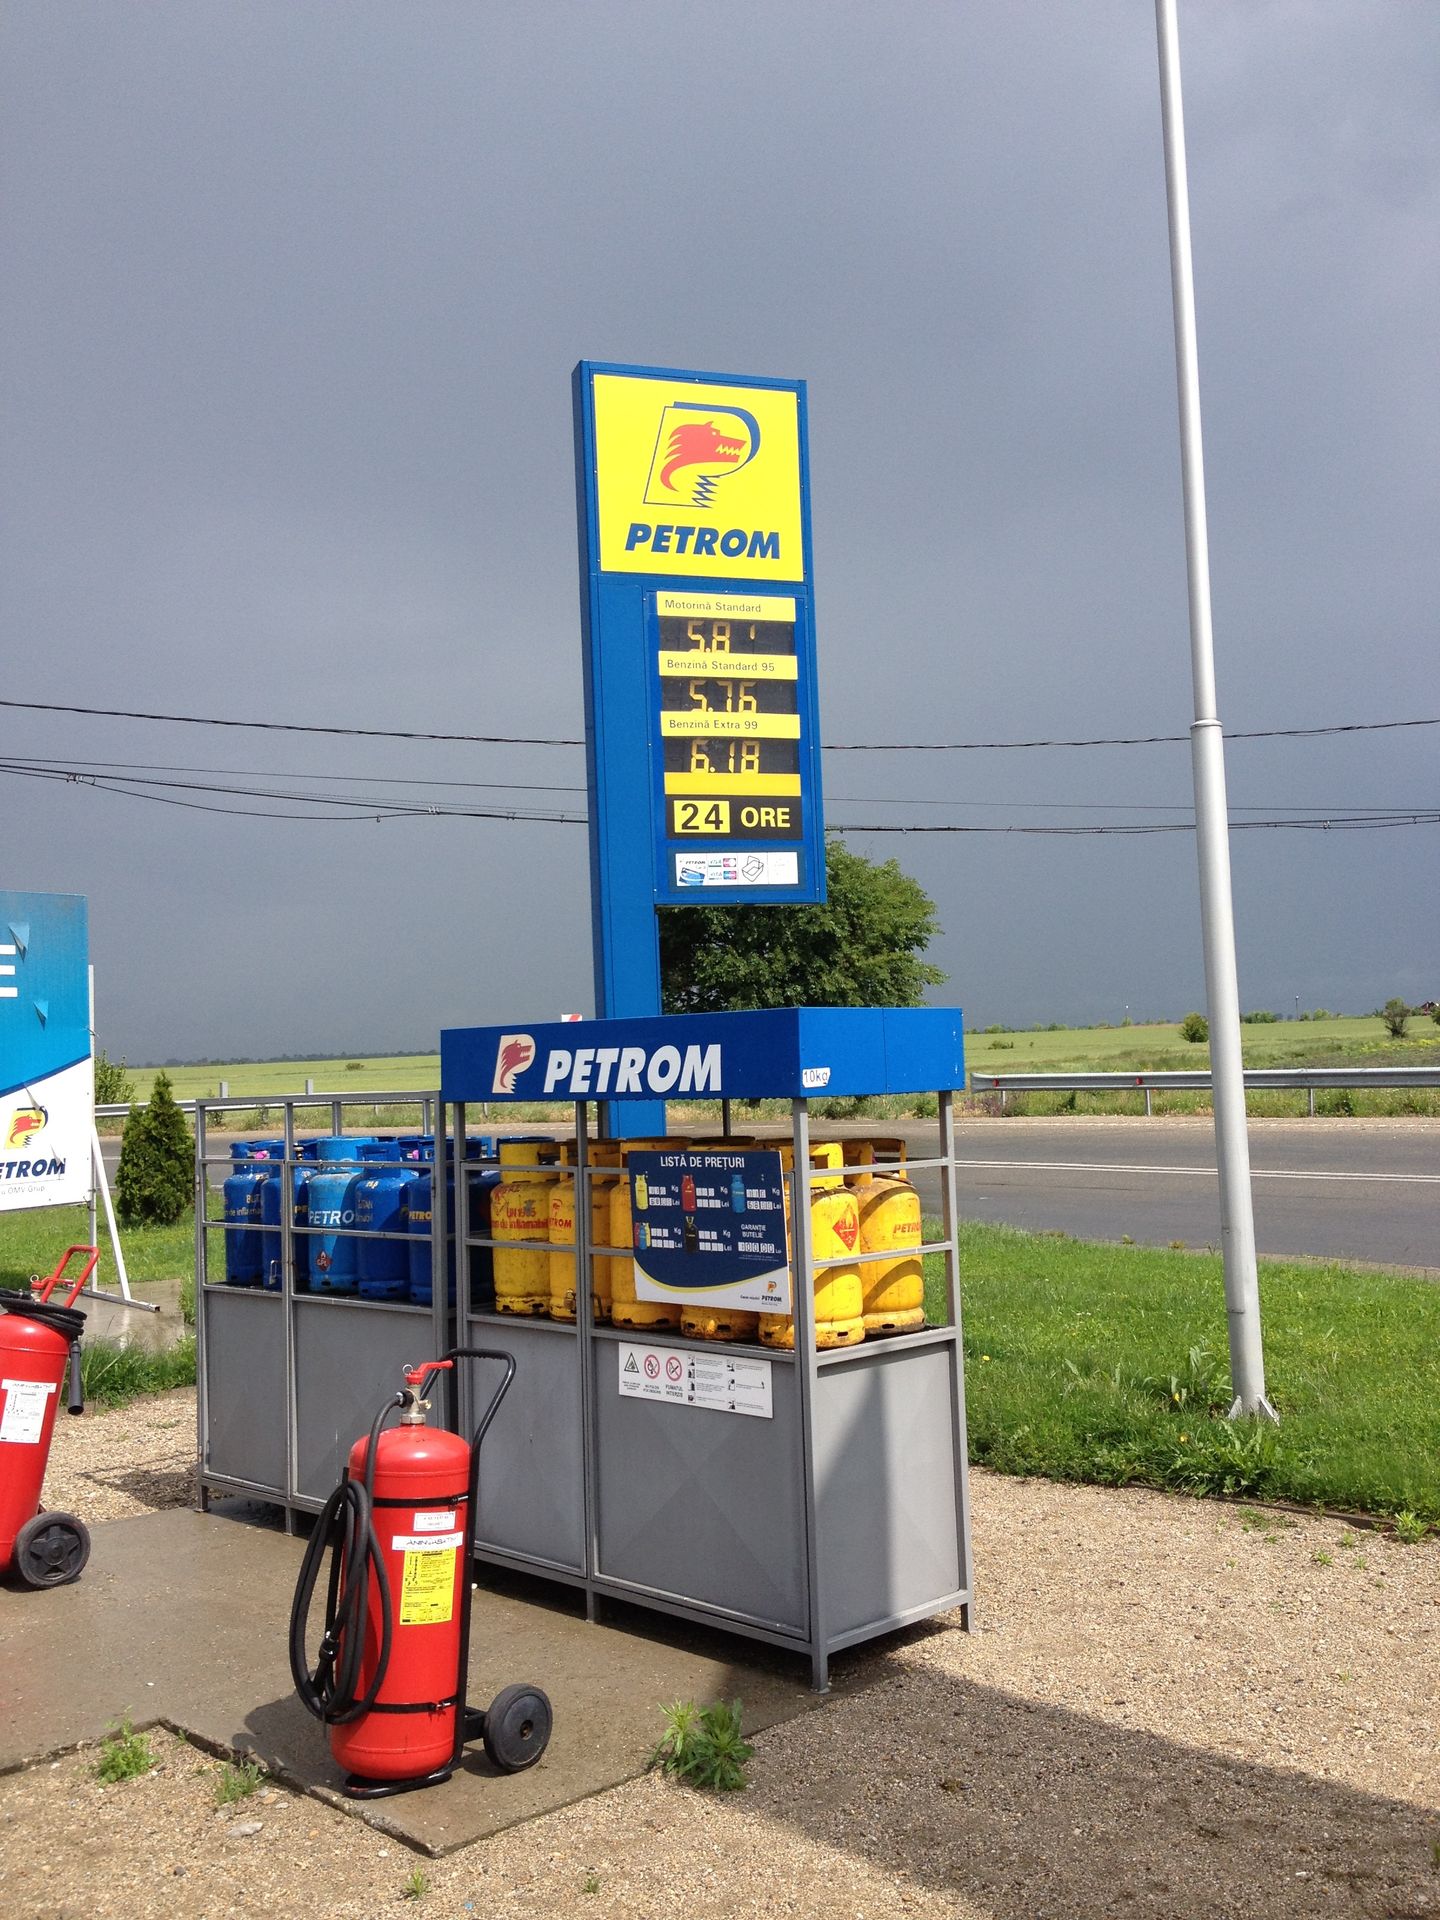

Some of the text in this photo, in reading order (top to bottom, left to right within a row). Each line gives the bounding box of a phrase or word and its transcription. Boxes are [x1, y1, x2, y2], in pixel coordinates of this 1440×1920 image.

[624, 523, 780, 560] PETROM
[664, 599, 761, 613] Motorină Standard
[667, 659, 775, 672] Benzină Standard 95
[689, 680, 757, 713] 5.76
[669, 719, 758, 729] Benzină Extra 99
[690, 740, 760, 774] 6.18
[681, 803, 791, 830] 24 ORE
[543, 1044, 722, 1094] PETROM
[660, 1154, 687, 1167] LISTĂ
[689, 1156, 703, 1168] DE
[308, 1209, 355, 1225] PETRO
